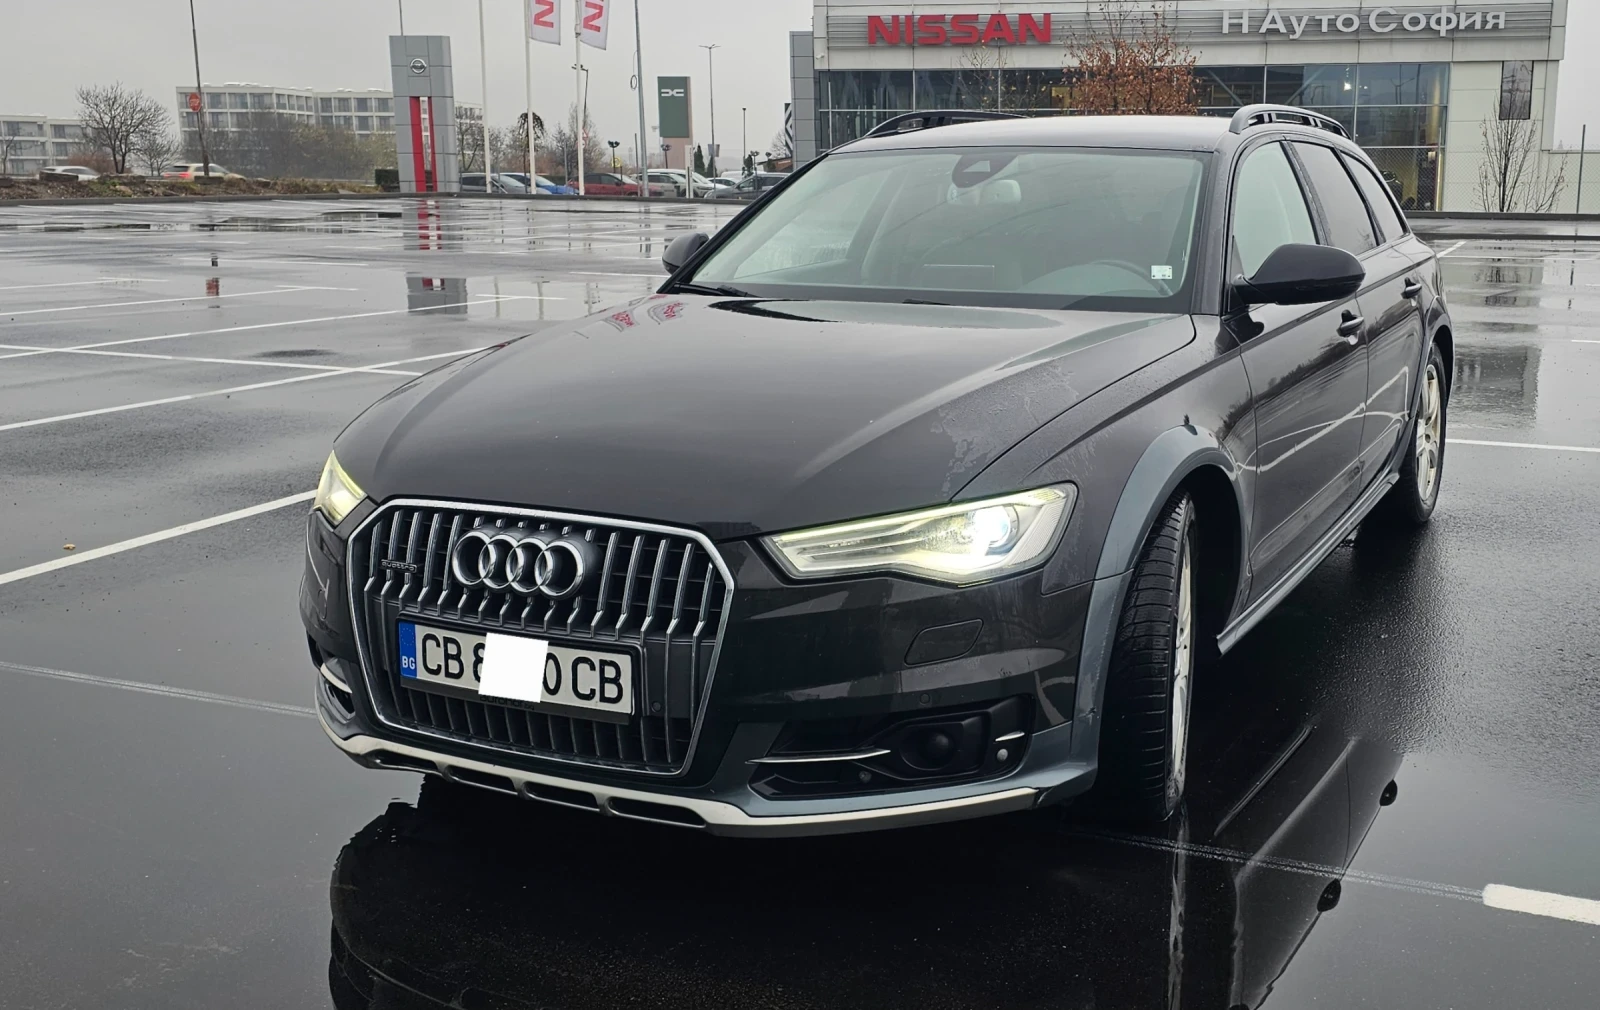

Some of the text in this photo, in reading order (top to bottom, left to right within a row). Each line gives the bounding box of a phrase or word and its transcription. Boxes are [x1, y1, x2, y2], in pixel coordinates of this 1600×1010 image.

[868, 13, 1052, 45] NISSAN
[381, 561, 415, 571] quattro
[402, 655, 416, 670] BG
[421, 632, 465, 680] CB
[571, 656, 624, 704] CB
